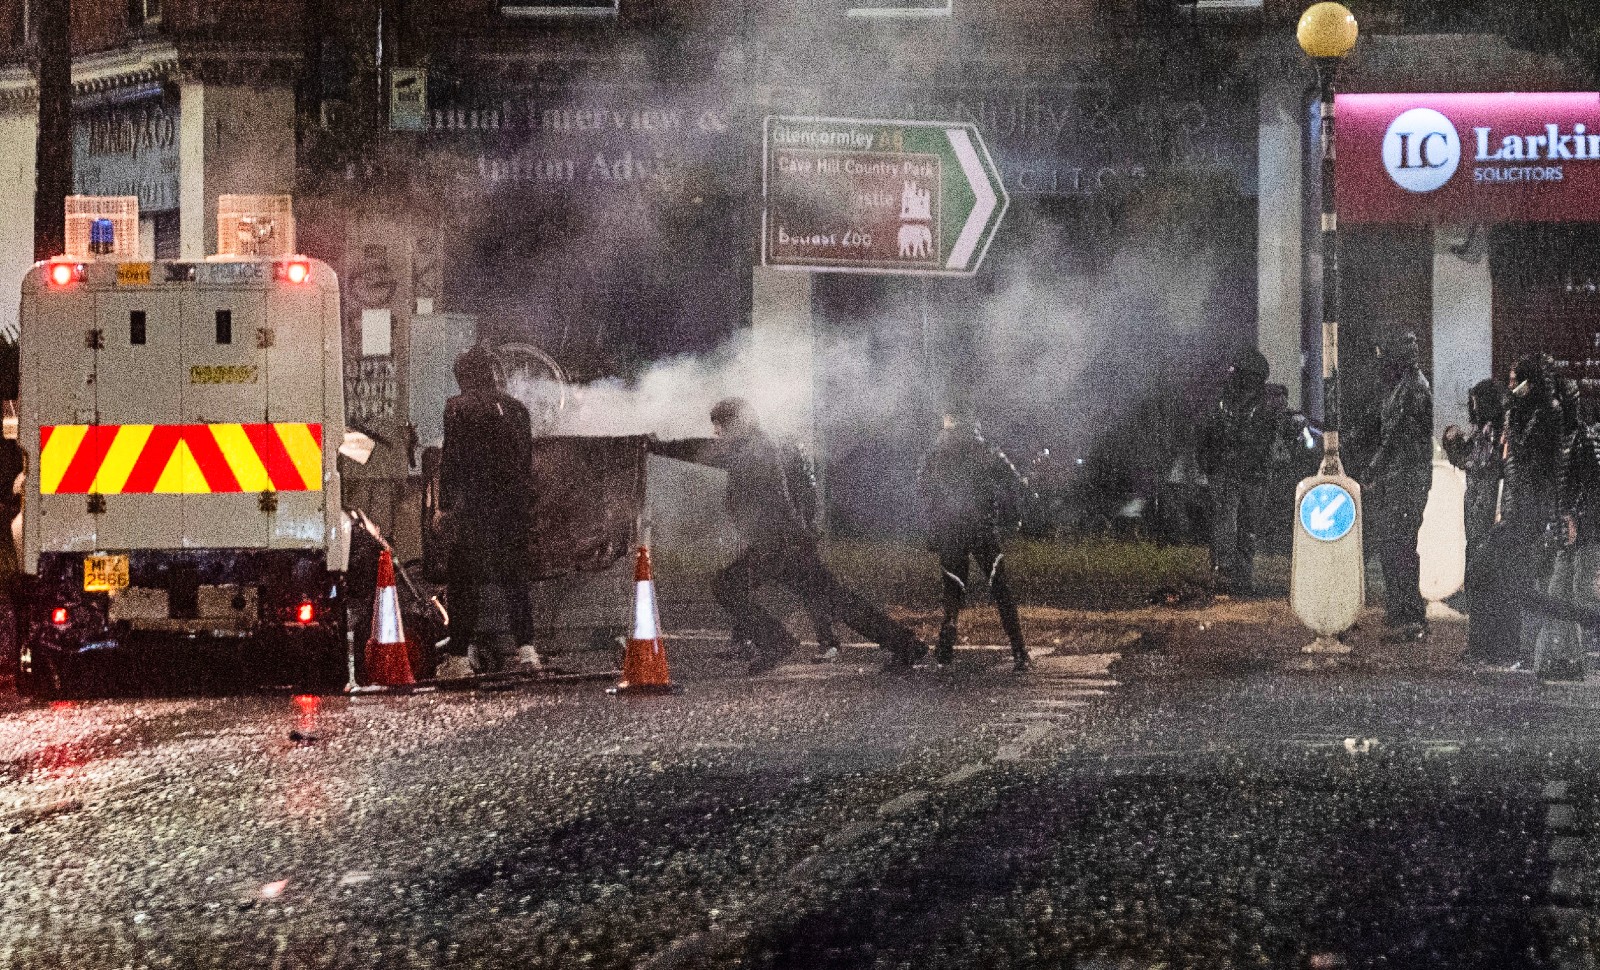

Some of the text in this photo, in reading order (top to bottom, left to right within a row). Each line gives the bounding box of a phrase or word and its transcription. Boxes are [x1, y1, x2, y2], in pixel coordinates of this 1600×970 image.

[779, 156, 934, 179] Cave Hill Country Park
[1474, 166, 1564, 182] SOLICITORS
